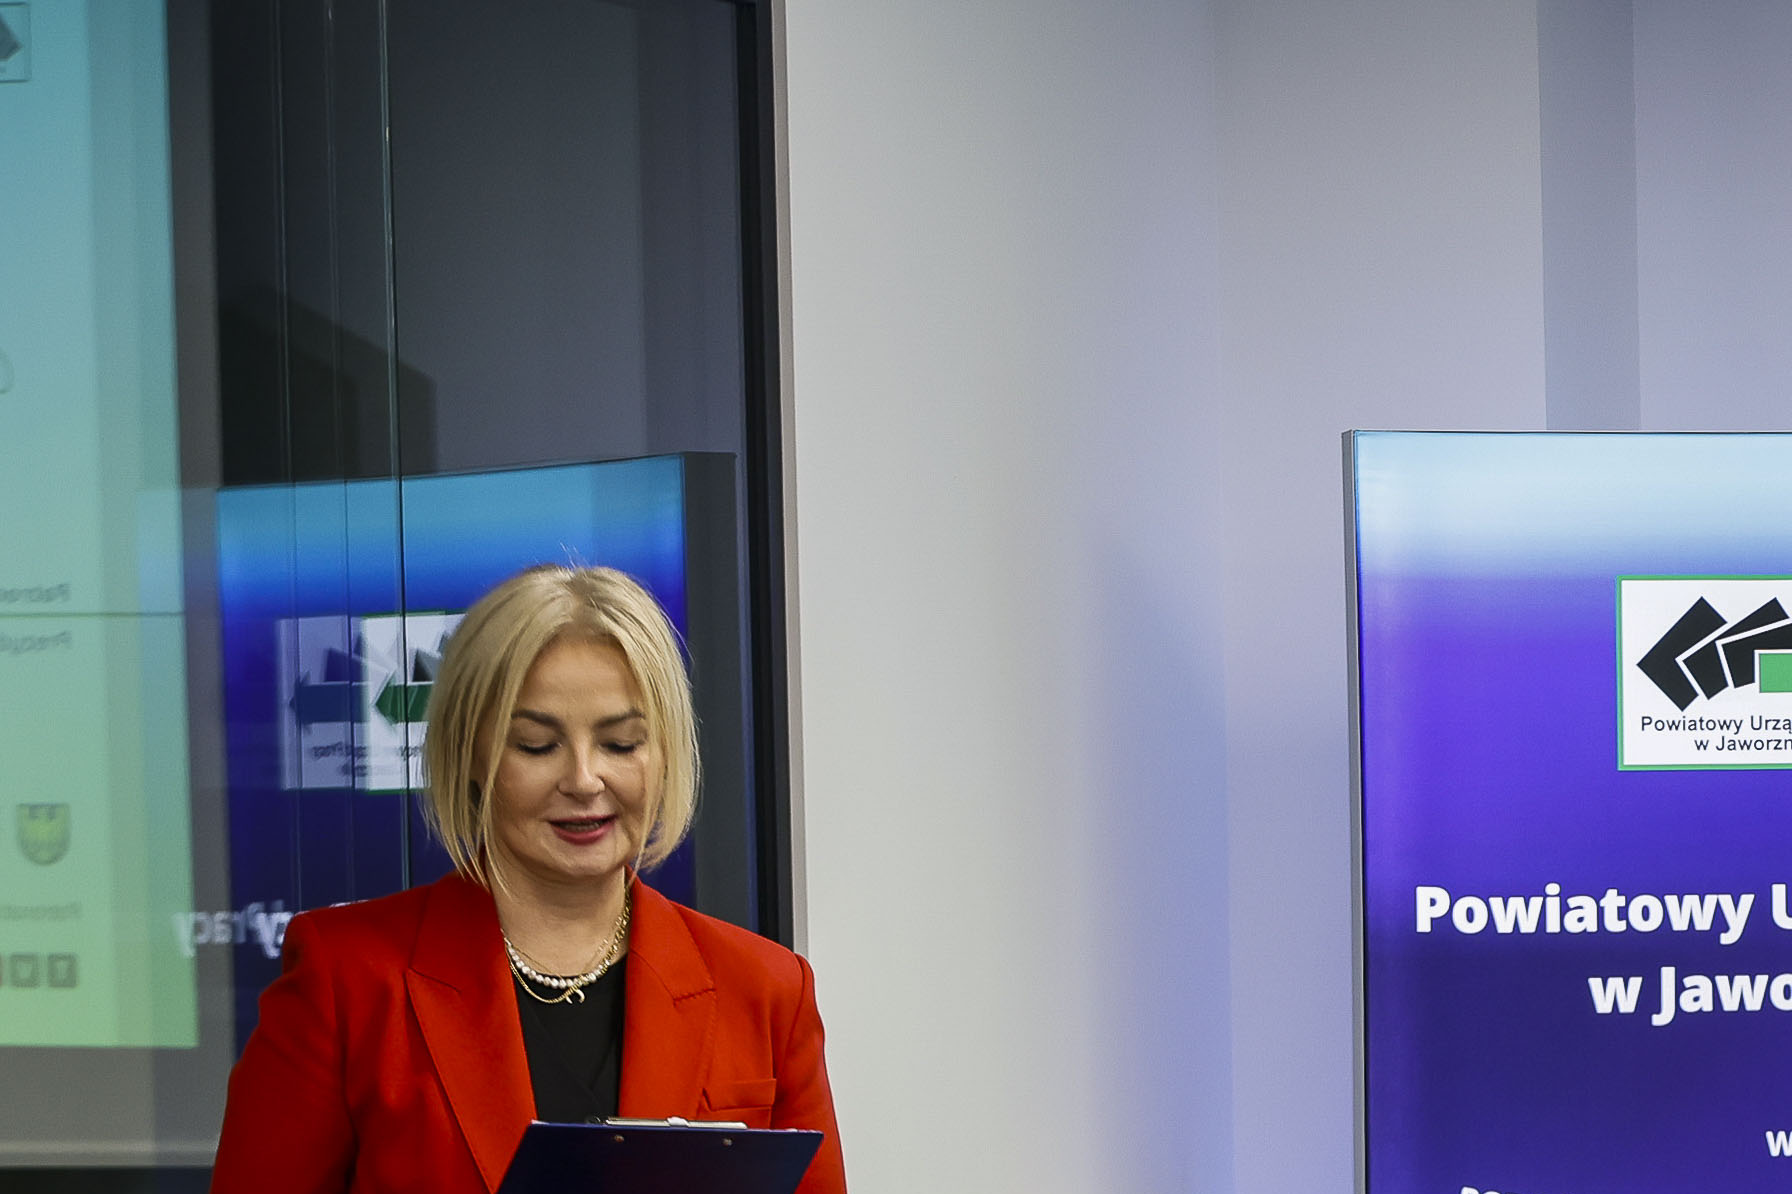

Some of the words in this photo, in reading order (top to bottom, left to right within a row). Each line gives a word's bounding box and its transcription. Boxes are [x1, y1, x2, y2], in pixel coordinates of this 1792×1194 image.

[1640, 715, 1743, 735] Powiatowy
[1694, 737, 1710, 751] w
[1415, 882, 1756, 945] Powiatowy
[1588, 976, 1642, 1013] w
